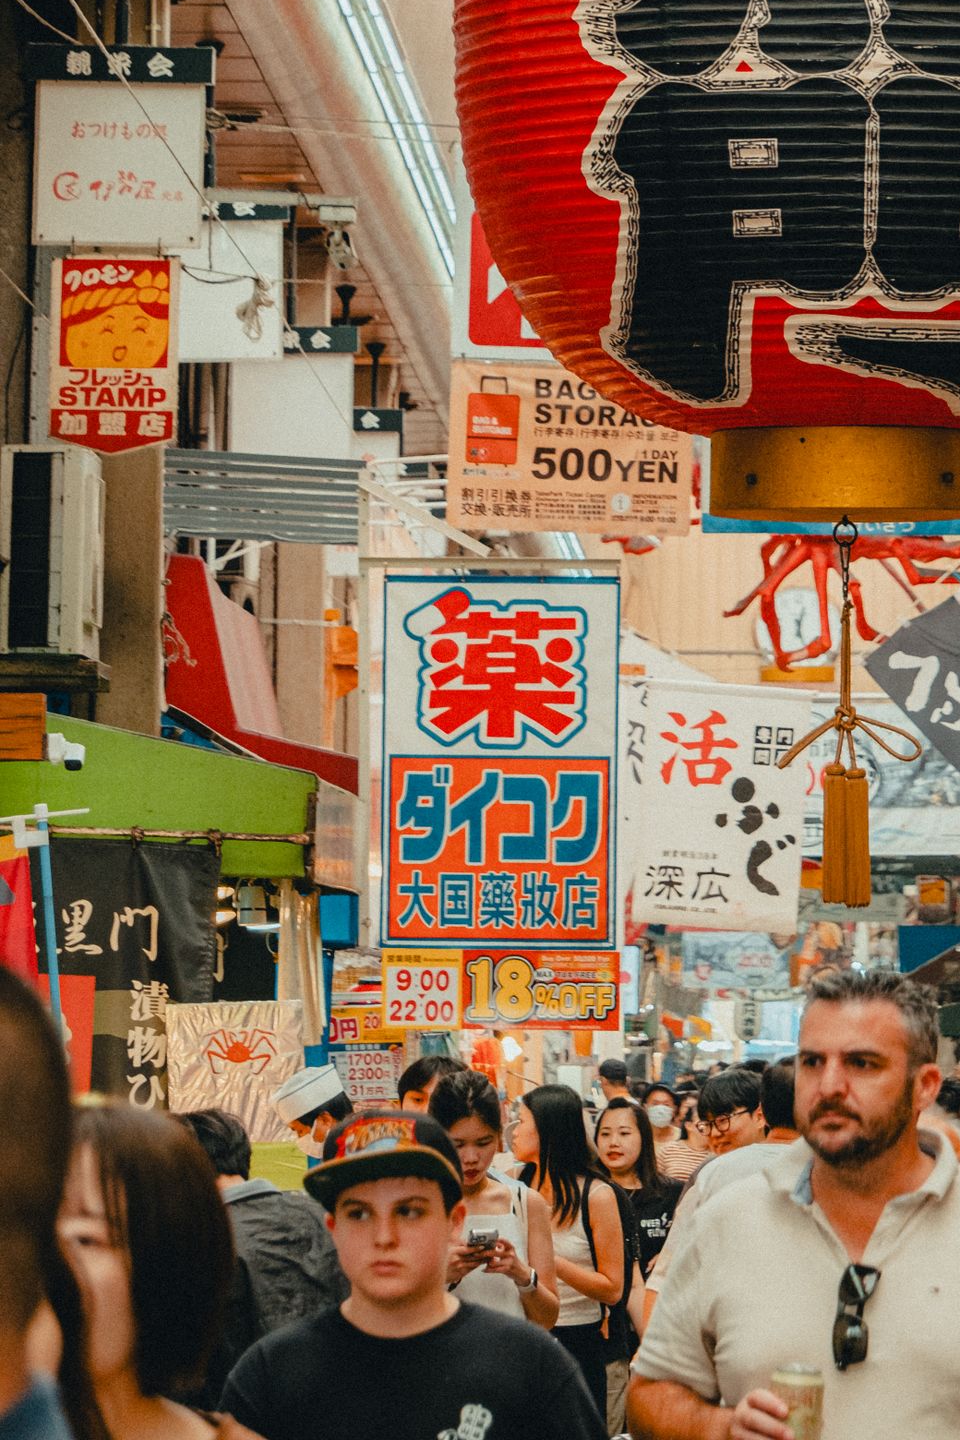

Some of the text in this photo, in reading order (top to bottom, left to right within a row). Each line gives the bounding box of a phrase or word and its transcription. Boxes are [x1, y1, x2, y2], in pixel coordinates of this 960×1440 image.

[64, 264, 135, 292] クロモン
[69, 369, 154, 387] フレッシュ
[59, 386, 167, 407] STAMP
[58, 411, 167, 437] 加盟店
[652, 449, 678, 461] DAY
[660, 710, 738, 788] 活
[397, 765, 602, 865] ダイコク
[644, 864, 731, 904] 深広
[396, 969, 450, 991] 9:00
[390, 1000, 454, 1023] 22:00
